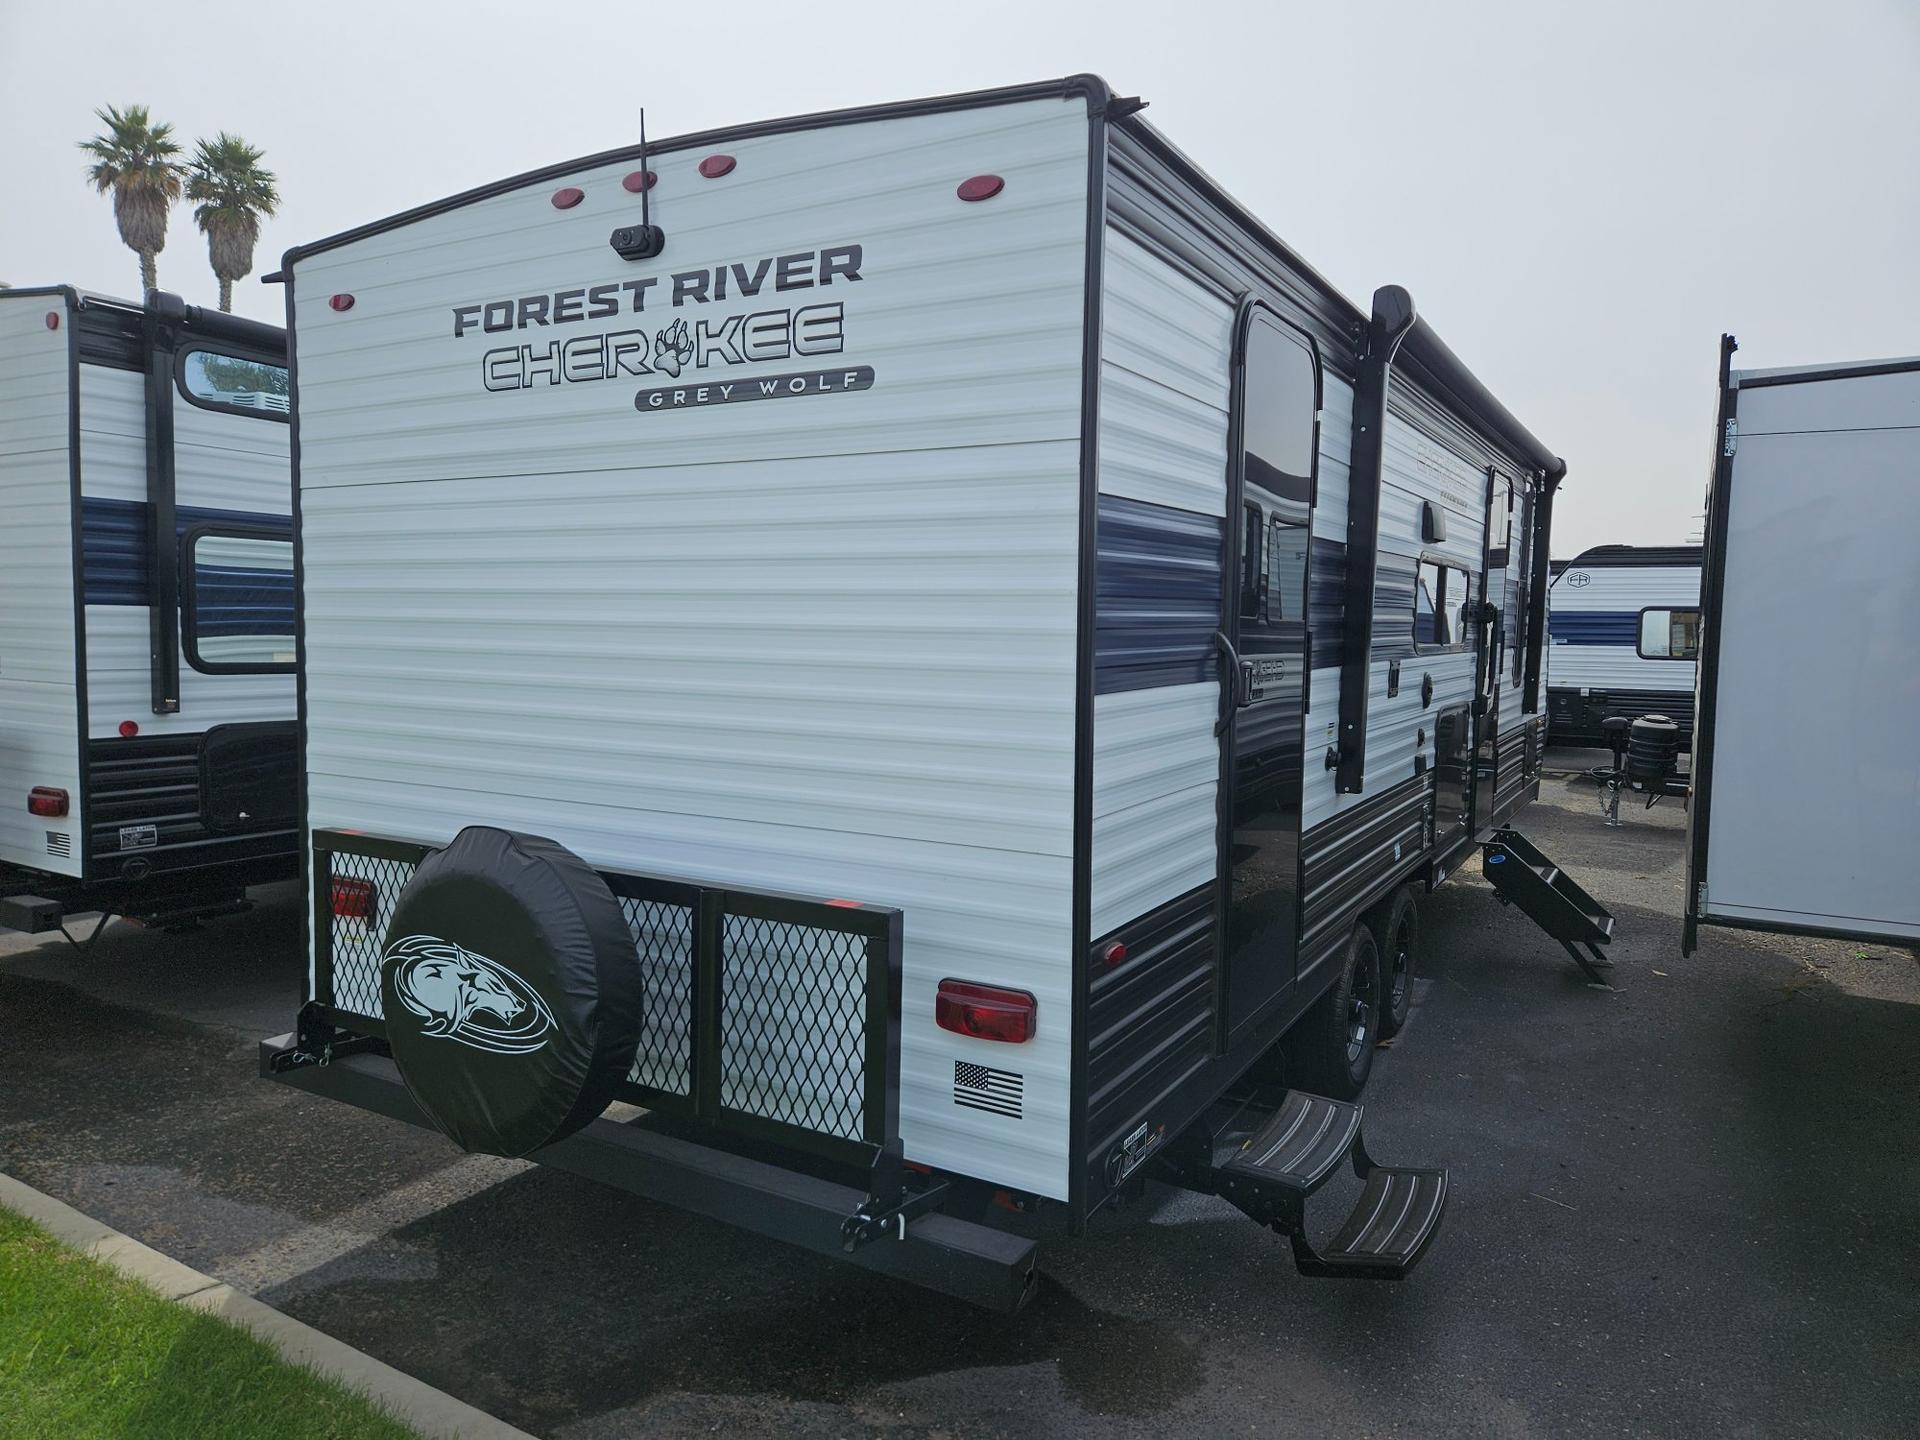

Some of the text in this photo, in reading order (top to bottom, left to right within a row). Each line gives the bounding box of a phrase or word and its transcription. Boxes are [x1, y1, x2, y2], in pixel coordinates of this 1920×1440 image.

[452, 244, 864, 338] FOREST RIVER
[649, 372, 857, 407] GREY WOLF
